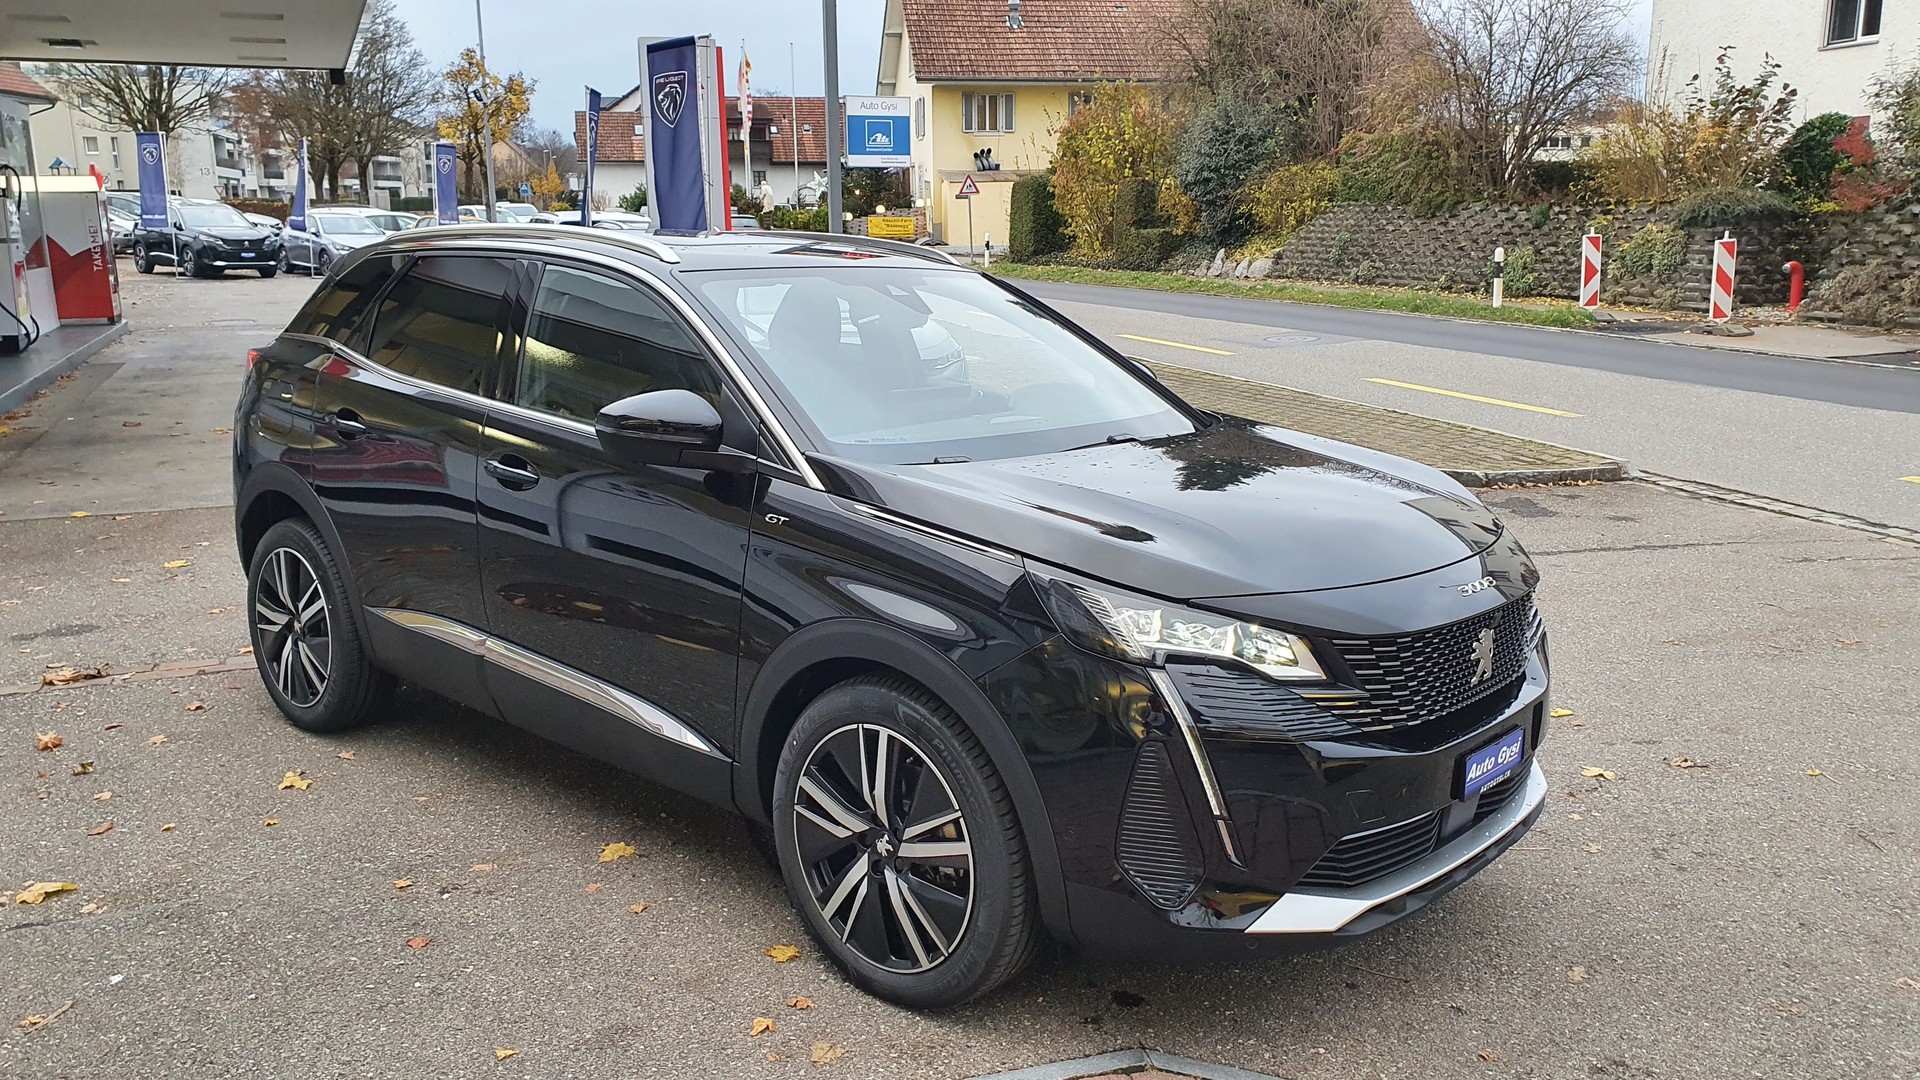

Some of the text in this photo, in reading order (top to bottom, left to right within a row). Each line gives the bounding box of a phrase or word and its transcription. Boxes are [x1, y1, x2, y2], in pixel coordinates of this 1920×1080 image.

[860, 101, 898, 112] Auto Gysi
[199, 167, 211, 176] 13
[88, 225, 104, 272] TAKE ME!
[764, 513, 790, 526] GT
[1457, 576, 1497, 597] 3008
[1466, 736, 1522, 782] Auto Gysi
